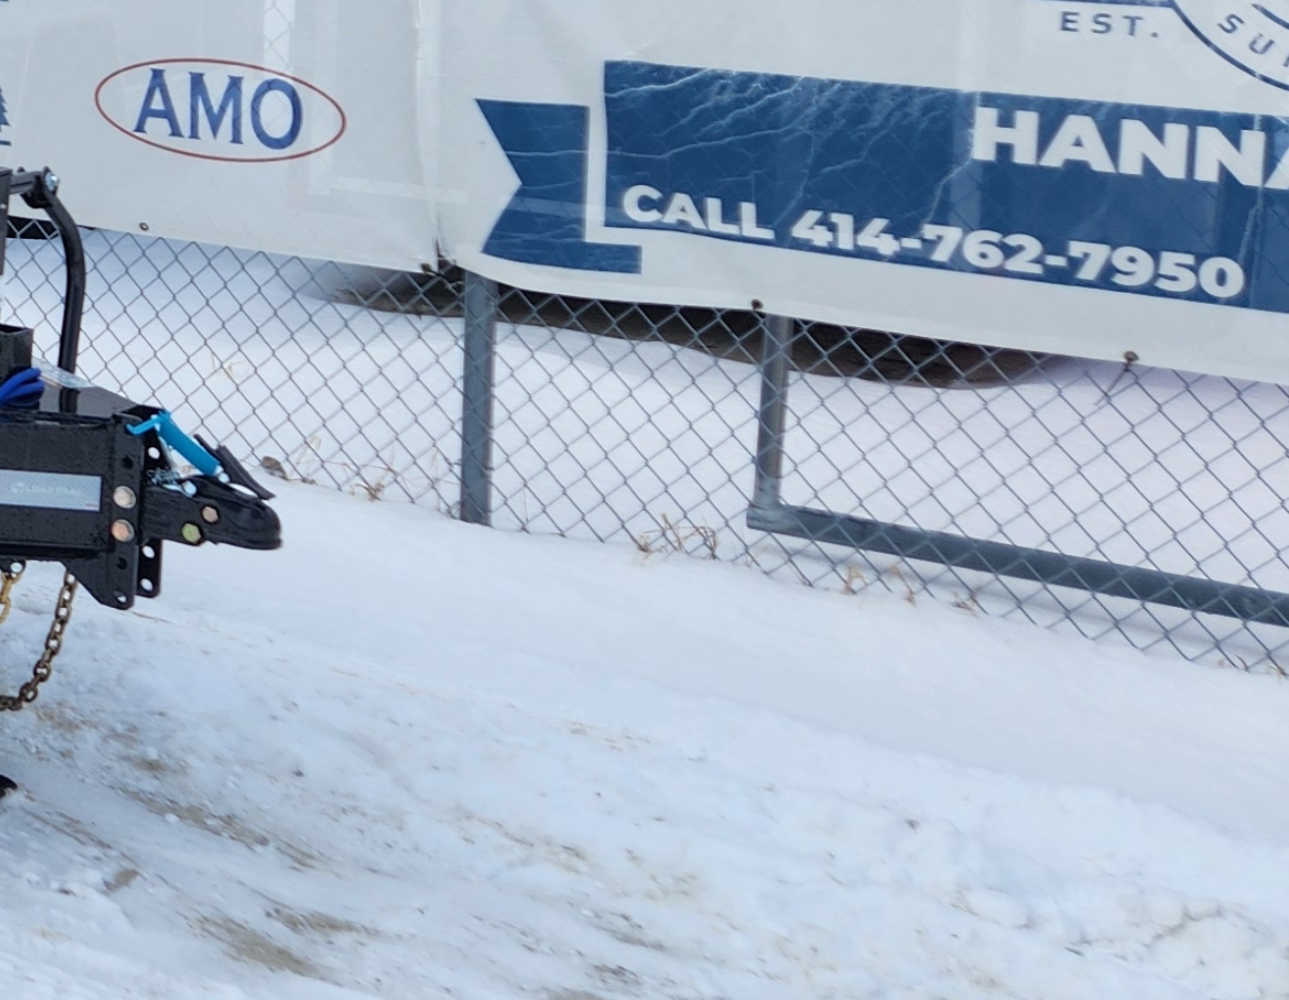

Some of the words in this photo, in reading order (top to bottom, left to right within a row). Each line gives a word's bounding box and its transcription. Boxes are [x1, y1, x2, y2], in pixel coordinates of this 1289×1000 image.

[1059, 10, 1160, 39] EST.
[132, 67, 303, 151] AMO
[622, 184, 775, 241] CALL
[791, 210, 1245, 299] 414-762-7950
